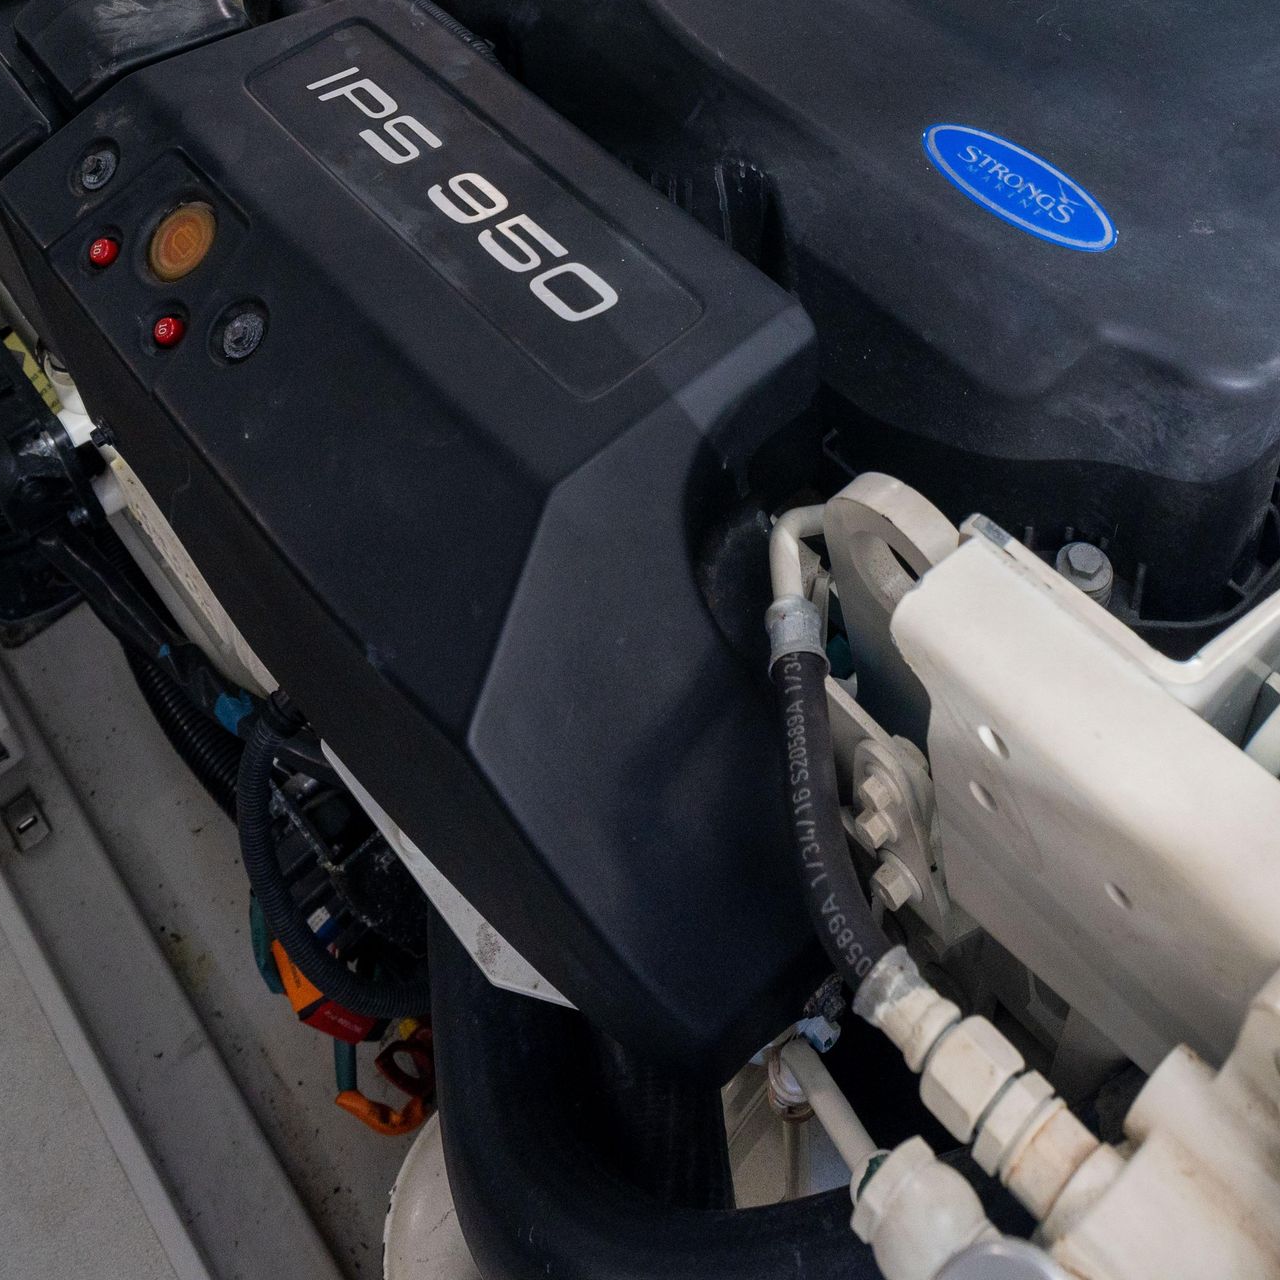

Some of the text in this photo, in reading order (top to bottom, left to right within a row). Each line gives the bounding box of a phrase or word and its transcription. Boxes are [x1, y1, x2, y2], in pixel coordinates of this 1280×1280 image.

[306, 66, 619, 322] IPS 950
[158, 323, 168, 335] 10
[786, 699, 809, 787] S20589A
